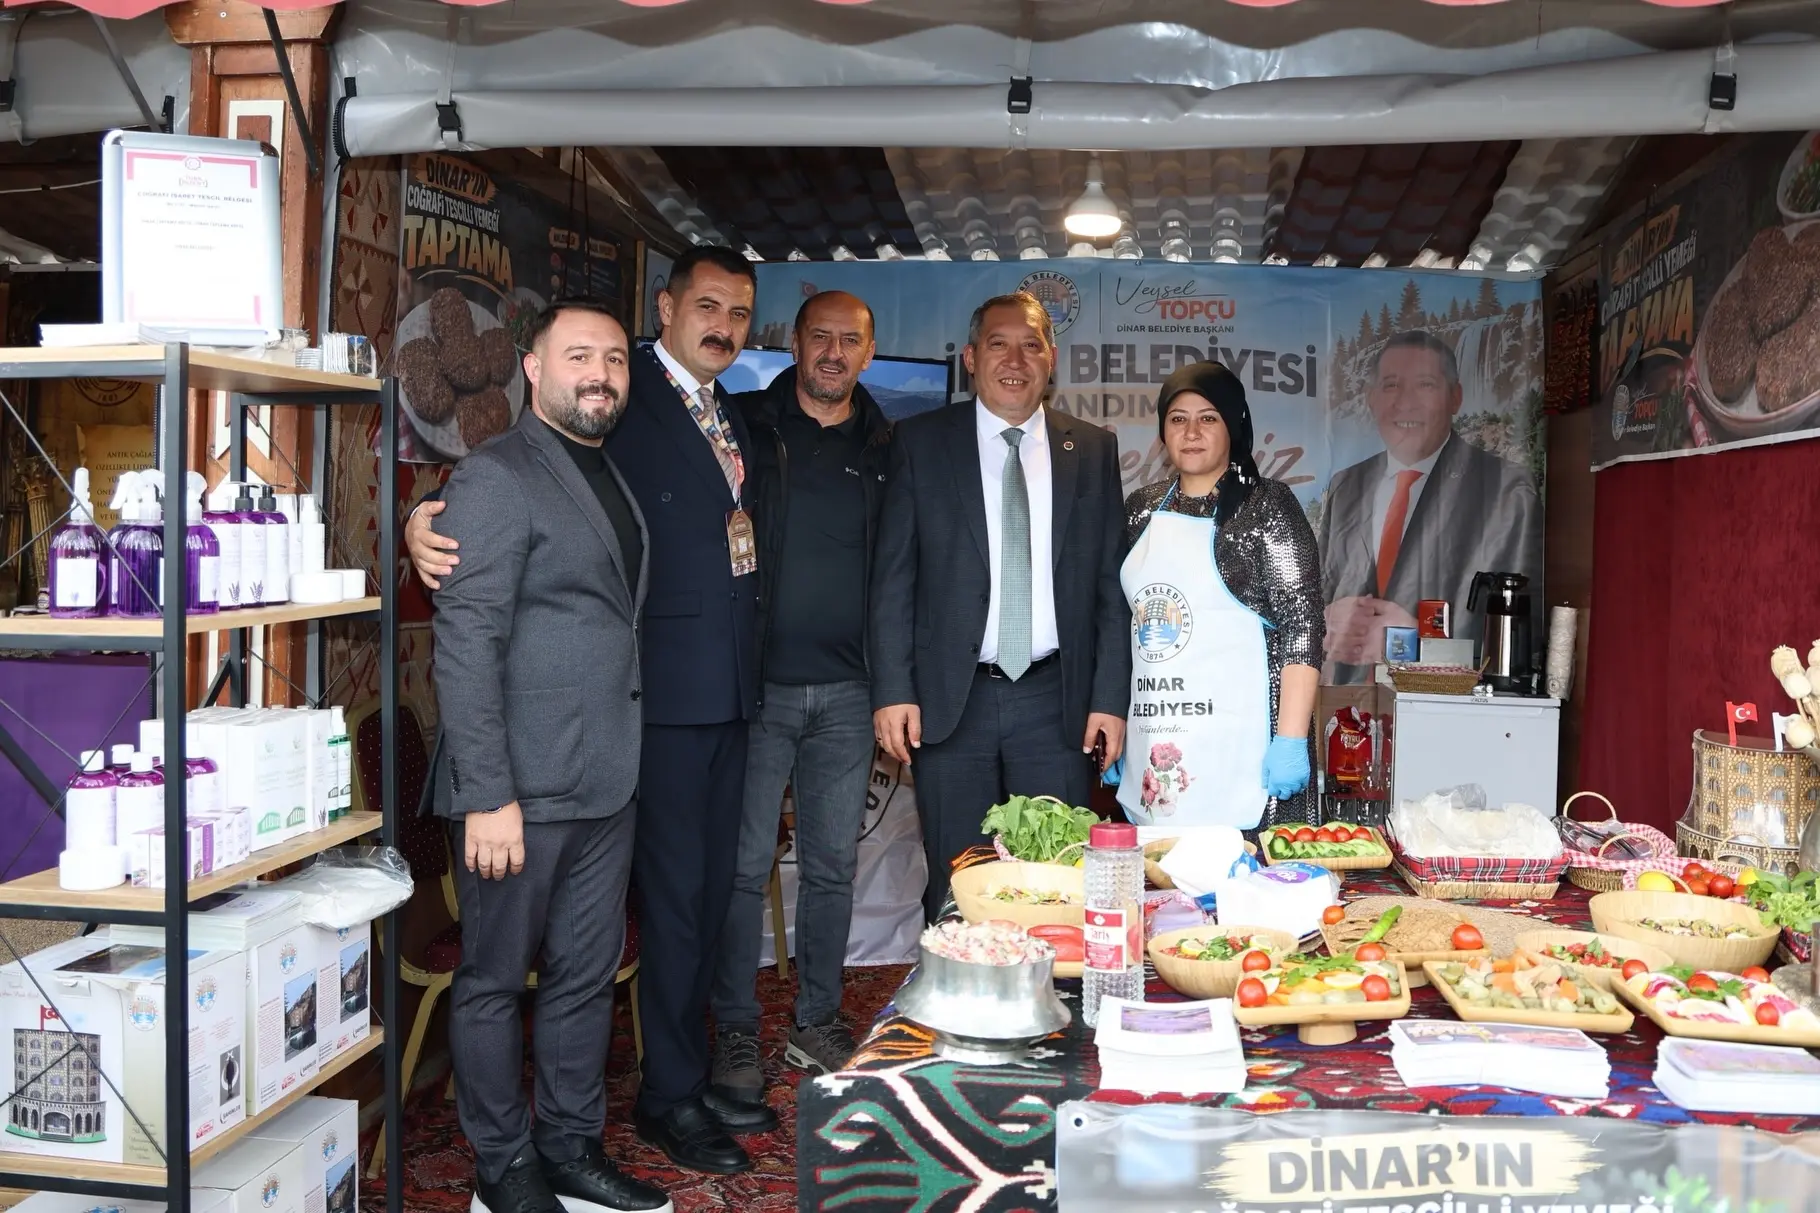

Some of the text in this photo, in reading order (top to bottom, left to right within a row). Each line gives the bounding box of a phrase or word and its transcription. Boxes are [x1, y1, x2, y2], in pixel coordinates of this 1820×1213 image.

[407, 184, 444, 215] COĞRAFİ
[474, 206, 500, 233] YEMEĞİ
[403, 215, 514, 293] TAPTAMA
[1115, 277, 1229, 314] Veysel
[1158, 299, 1236, 323] TOPÇU
[1117, 323, 1235, 335] DİNAR BELEDİYE BAŞKANI
[1052, 393, 1158, 418] ANDIM
[130, 448, 154, 460] ÇAĞLA
[132, 463, 154, 471] LİDYA
[1146, 652, 1164, 660] 1874
[1137, 674, 1184, 692] DİNAR
[1268, 1136, 1533, 1194] DİNAR'IN
